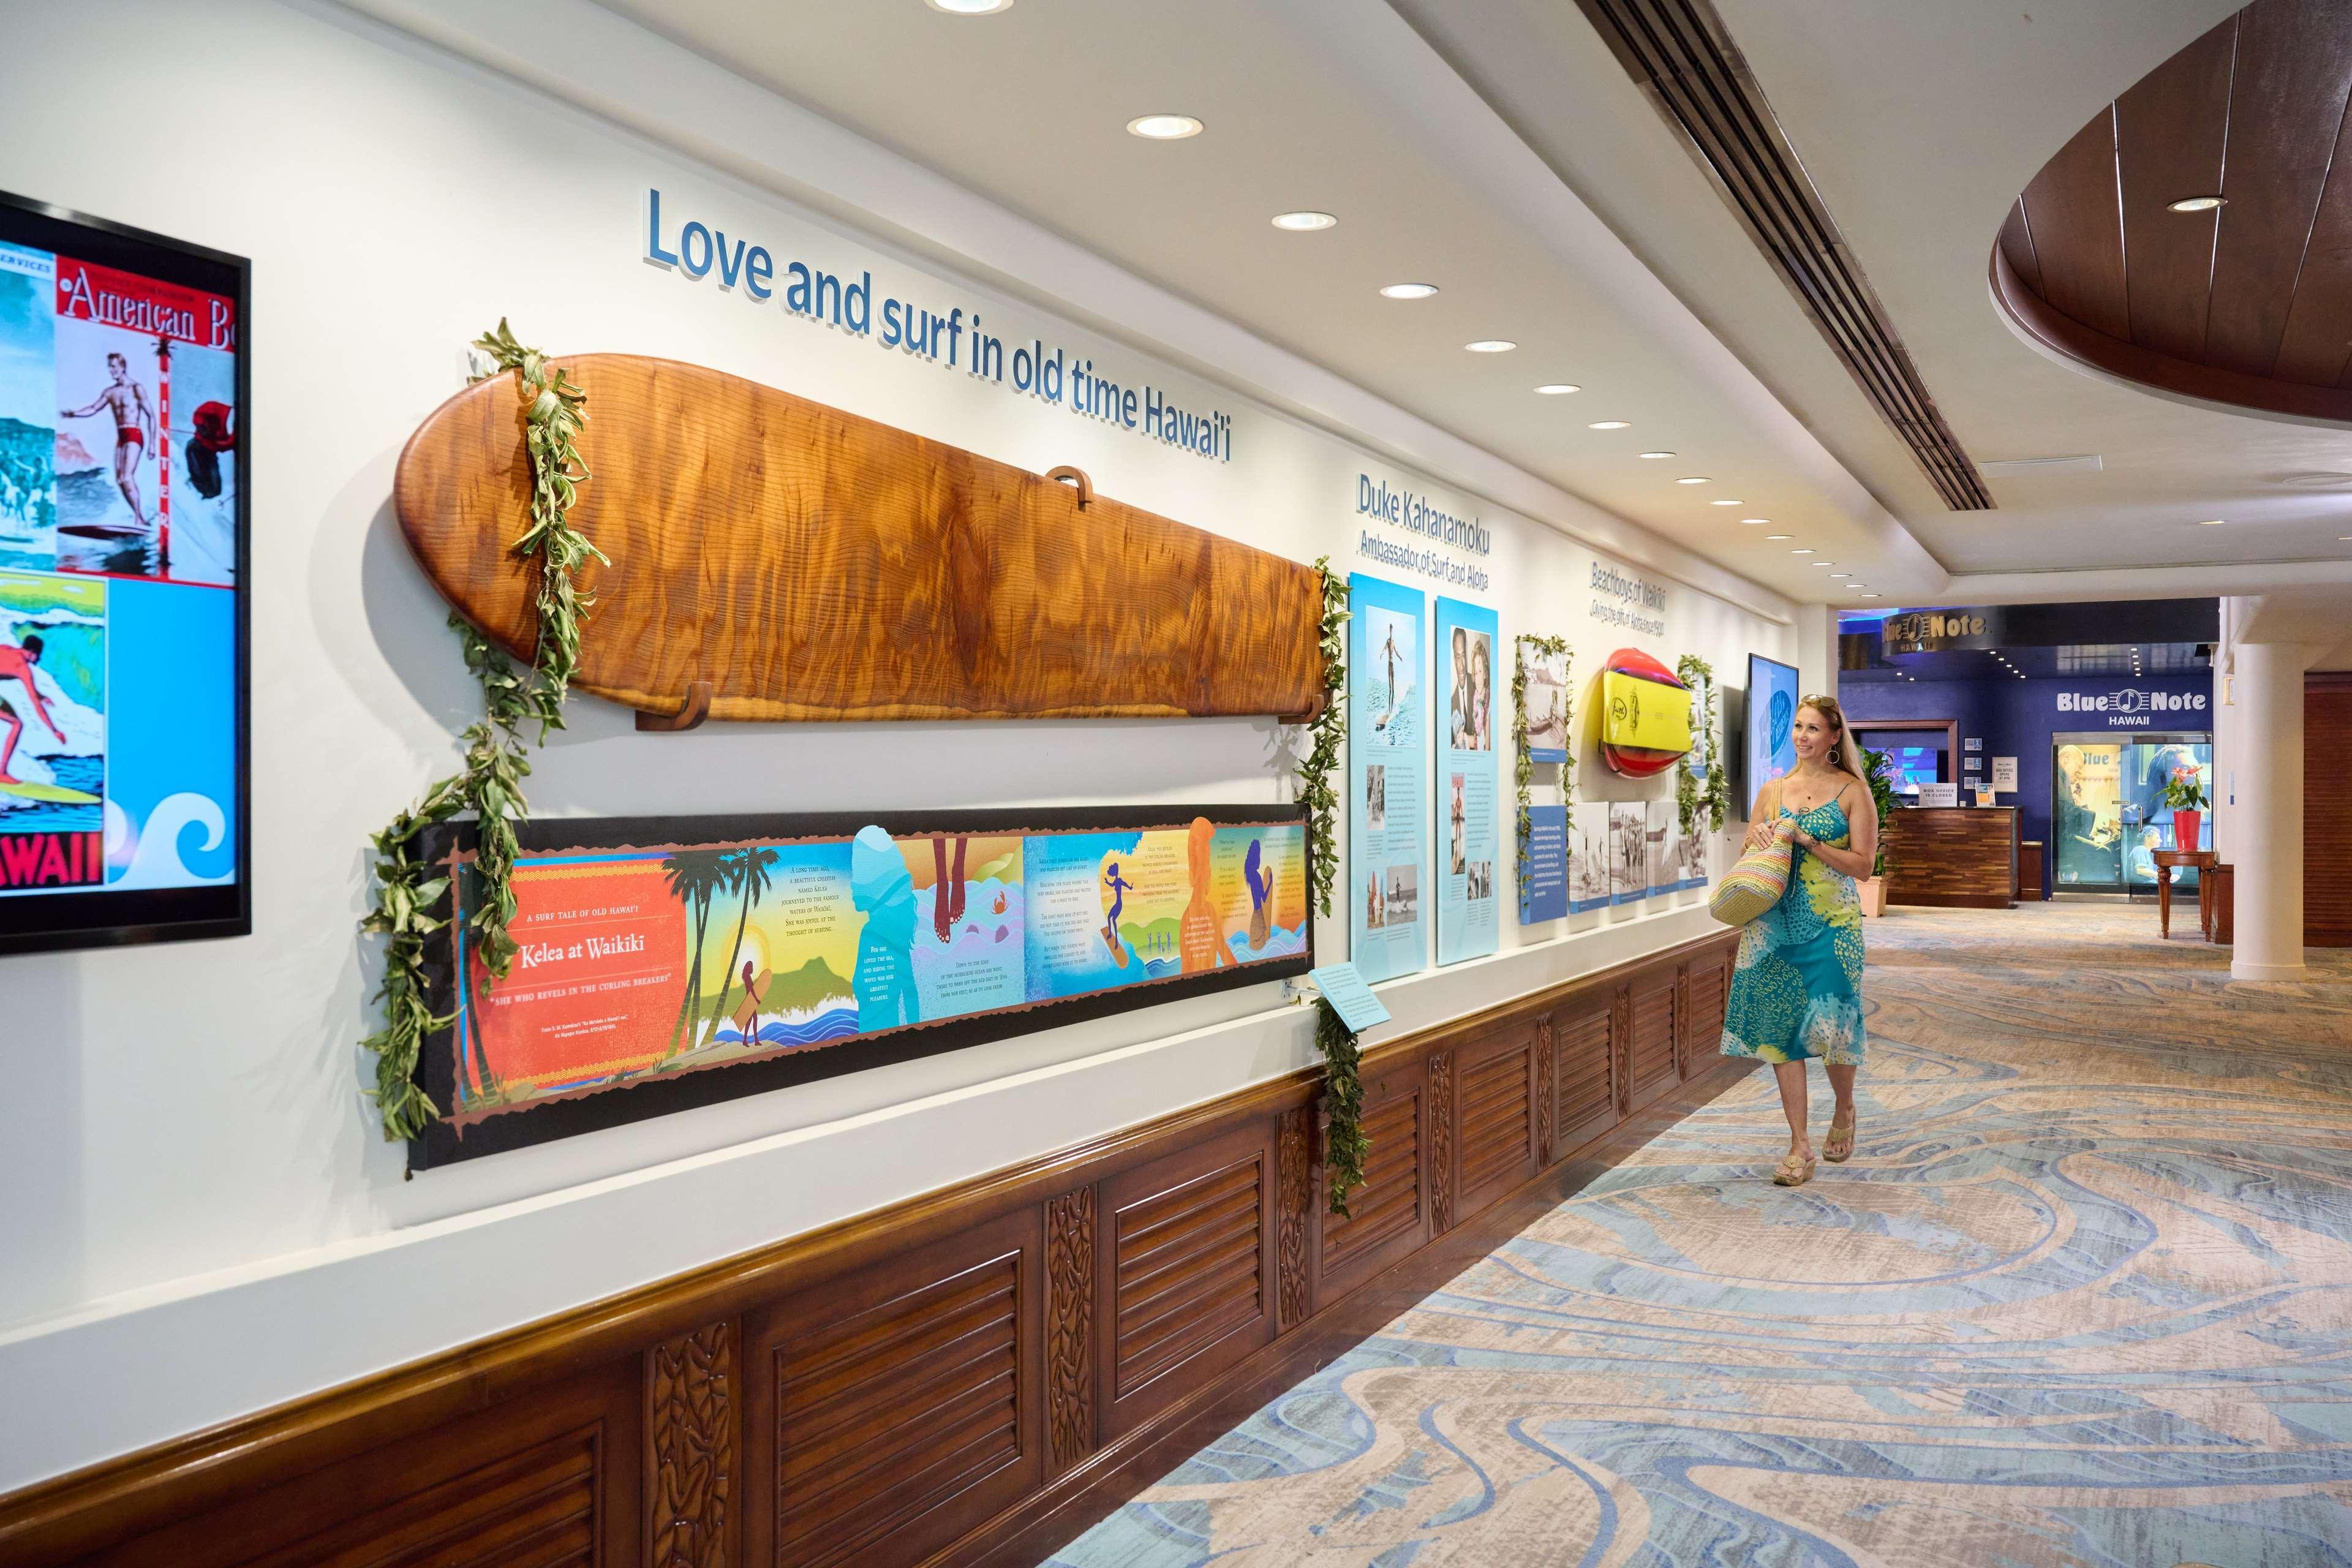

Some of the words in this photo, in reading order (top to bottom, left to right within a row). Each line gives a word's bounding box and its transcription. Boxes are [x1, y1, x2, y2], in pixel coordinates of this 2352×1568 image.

[0, 254, 51, 274] ERVICES
[64, 267, 196, 341] American
[650, 189, 772, 298] Love
[786, 262, 870, 334] and
[883, 298, 962, 366] surf
[971, 314, 1002, 382] in
[1012, 340, 1062, 402] old
[1071, 360, 1137, 428] time
[1360, 473, 1399, 523] Duke
[1403, 491, 1490, 555] Kahanamoku
[1360, 529, 1419, 568] Ambassador
[1420, 550, 1430, 570] of
[1431, 553, 1449, 578] Surf
[1450, 562, 1465, 582] and
[1467, 565, 1488, 589] Aloha
[1592, 561, 1632, 603] Beachboys
[1633, 578, 1642, 603] of
[1931, 614, 1986, 638] Note
[2057, 693, 2108, 711] Blue
[2150, 692, 2206, 710] Note
[2109, 716, 2149, 725] HAWAII
[0, 833, 100, 886] WAII
[535, 913, 555, 922] SURF
[557, 911, 577, 920] TALE
[579, 909, 589, 918] OF
[592, 908, 607, 917] OLD
[521, 943, 564, 968] Kelea
[568, 943, 582, 960] at
[514, 992, 535, 1003] WHO
[537, 989, 567, 1001] REVELS
[568, 987, 578, 996] IN
[581, 984, 597, 995] THE
[598, 979, 631, 992] CURLING
